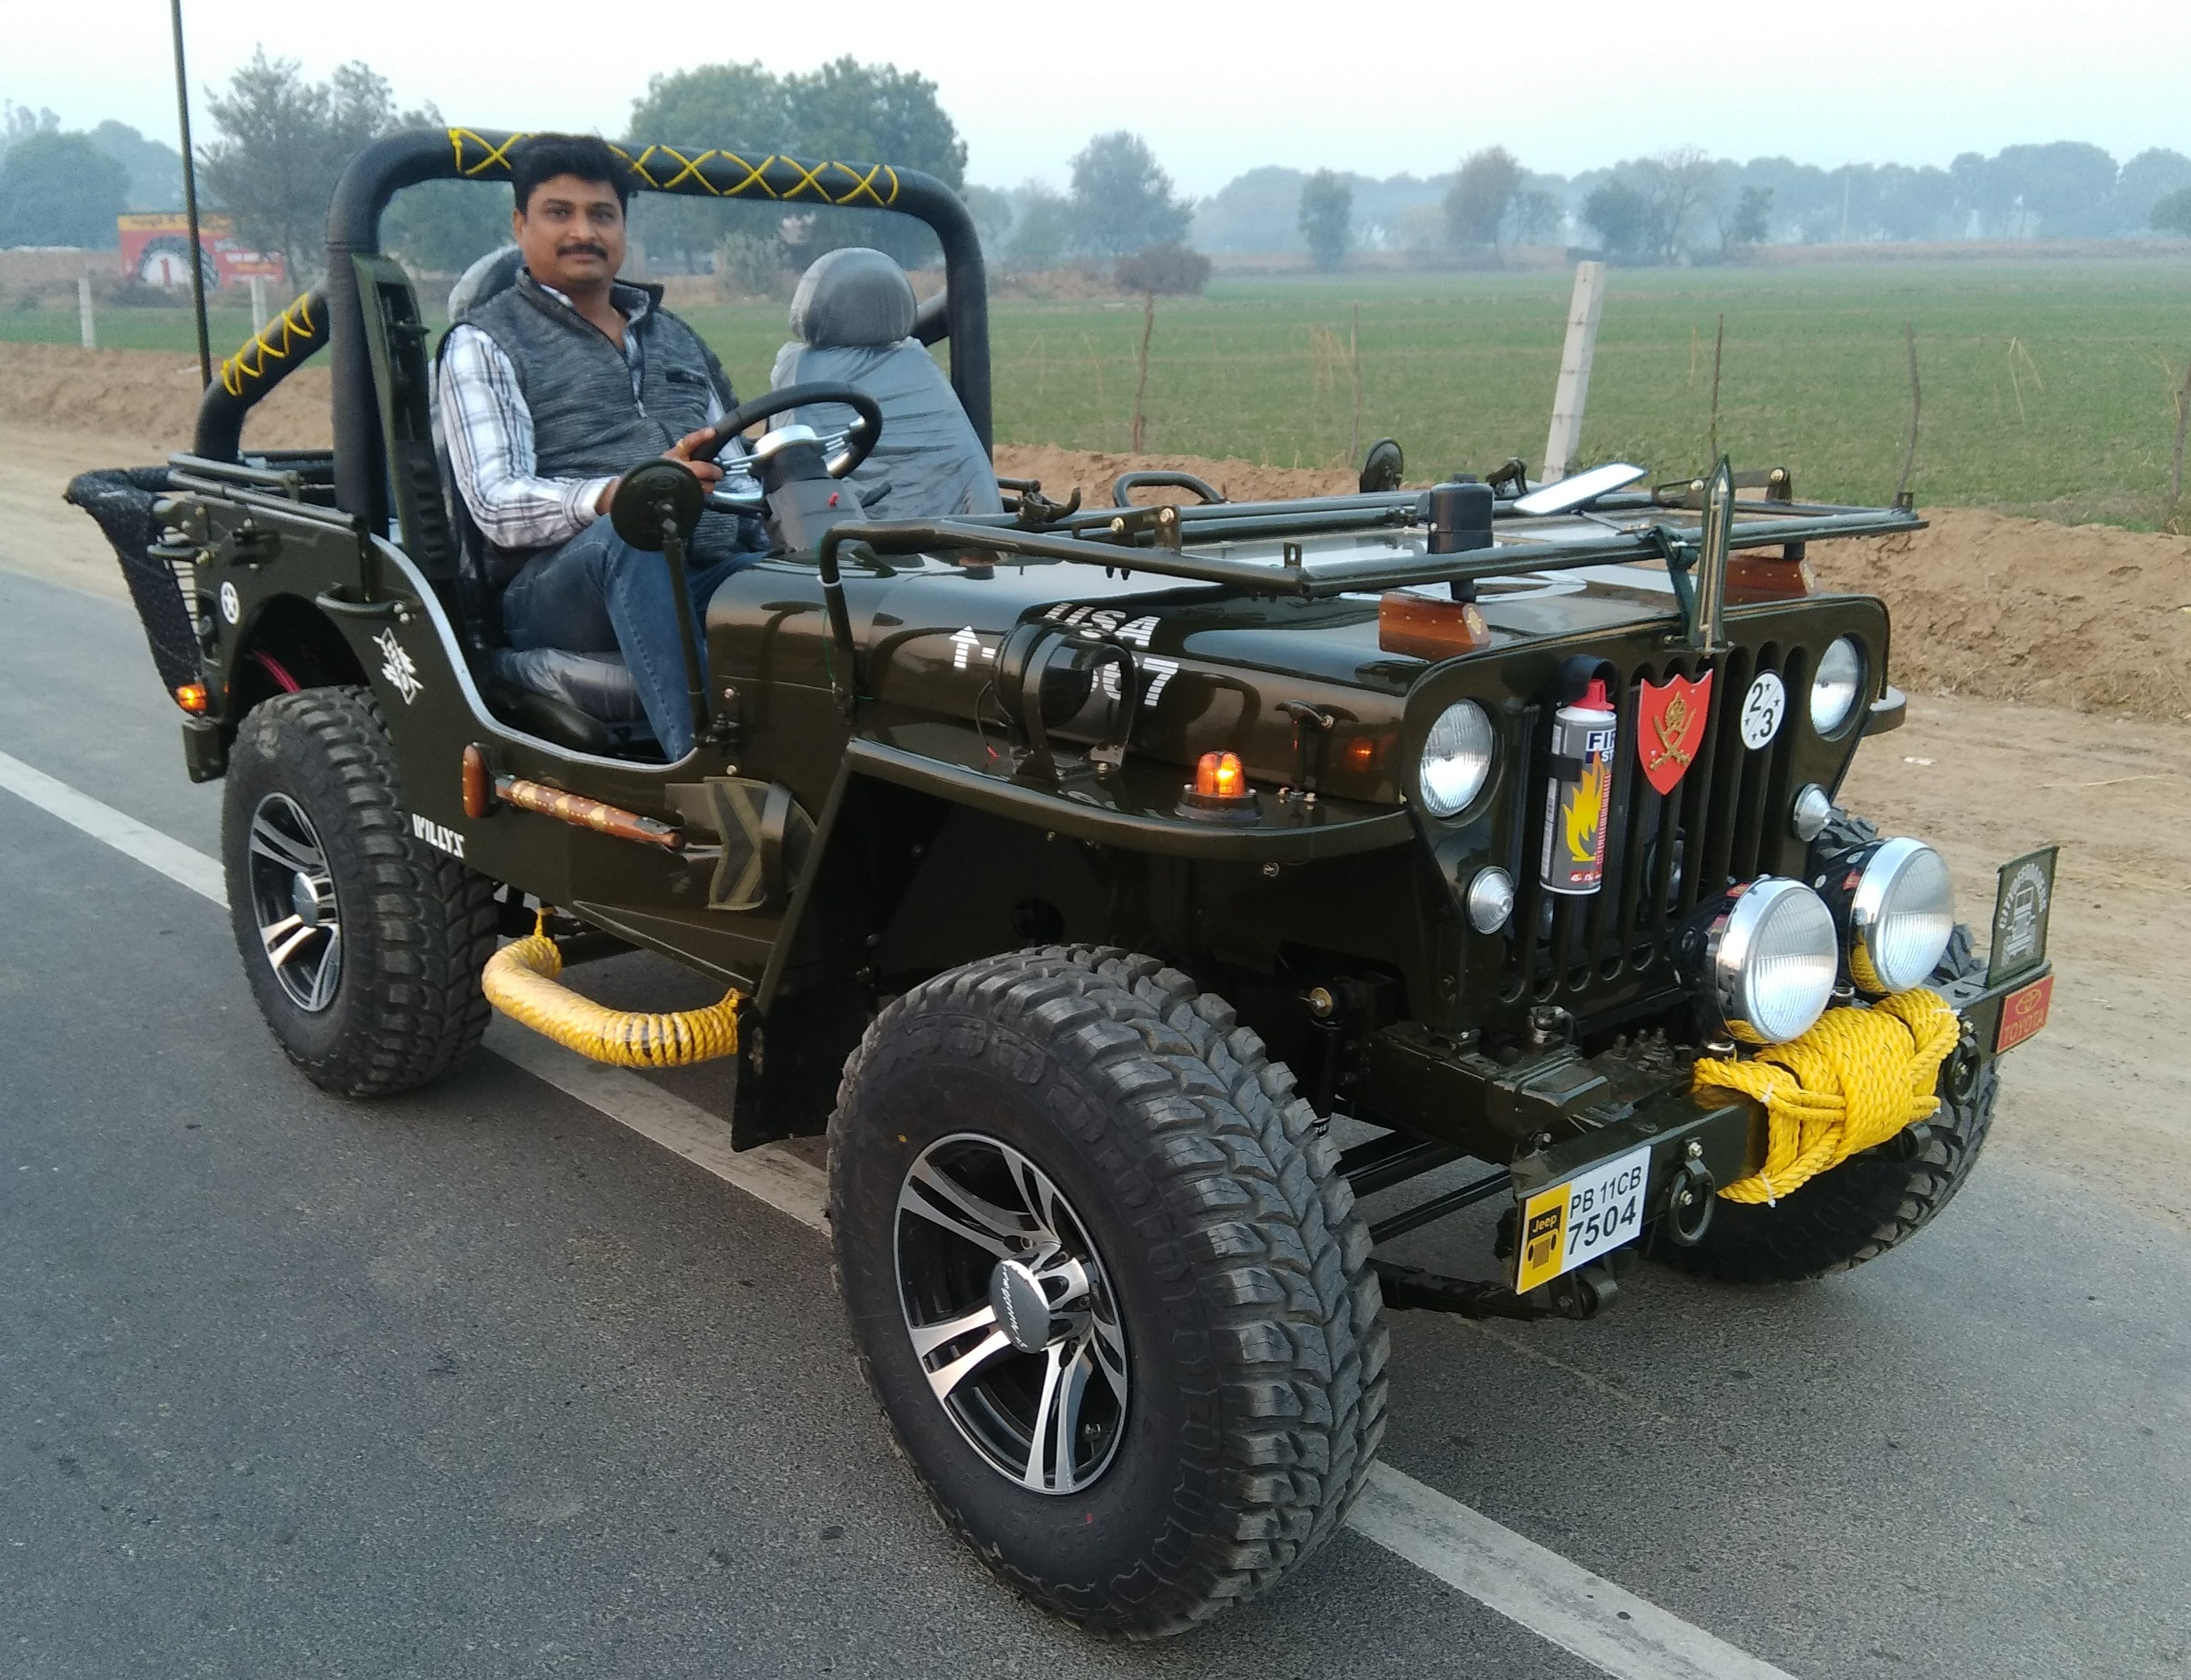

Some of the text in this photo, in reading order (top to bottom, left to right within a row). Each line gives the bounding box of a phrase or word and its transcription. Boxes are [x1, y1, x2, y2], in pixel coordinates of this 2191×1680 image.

[1044, 603, 1161, 646] USA
[1749, 682, 1764, 712] 2
[1760, 707, 1774, 738] 3
[2003, 1008, 2045, 1041] TOYOTA
[1569, 1166, 1642, 1219] PB 11CB
[1532, 1214, 1557, 1233] Jeep
[1568, 1195, 1637, 1255] 7504
